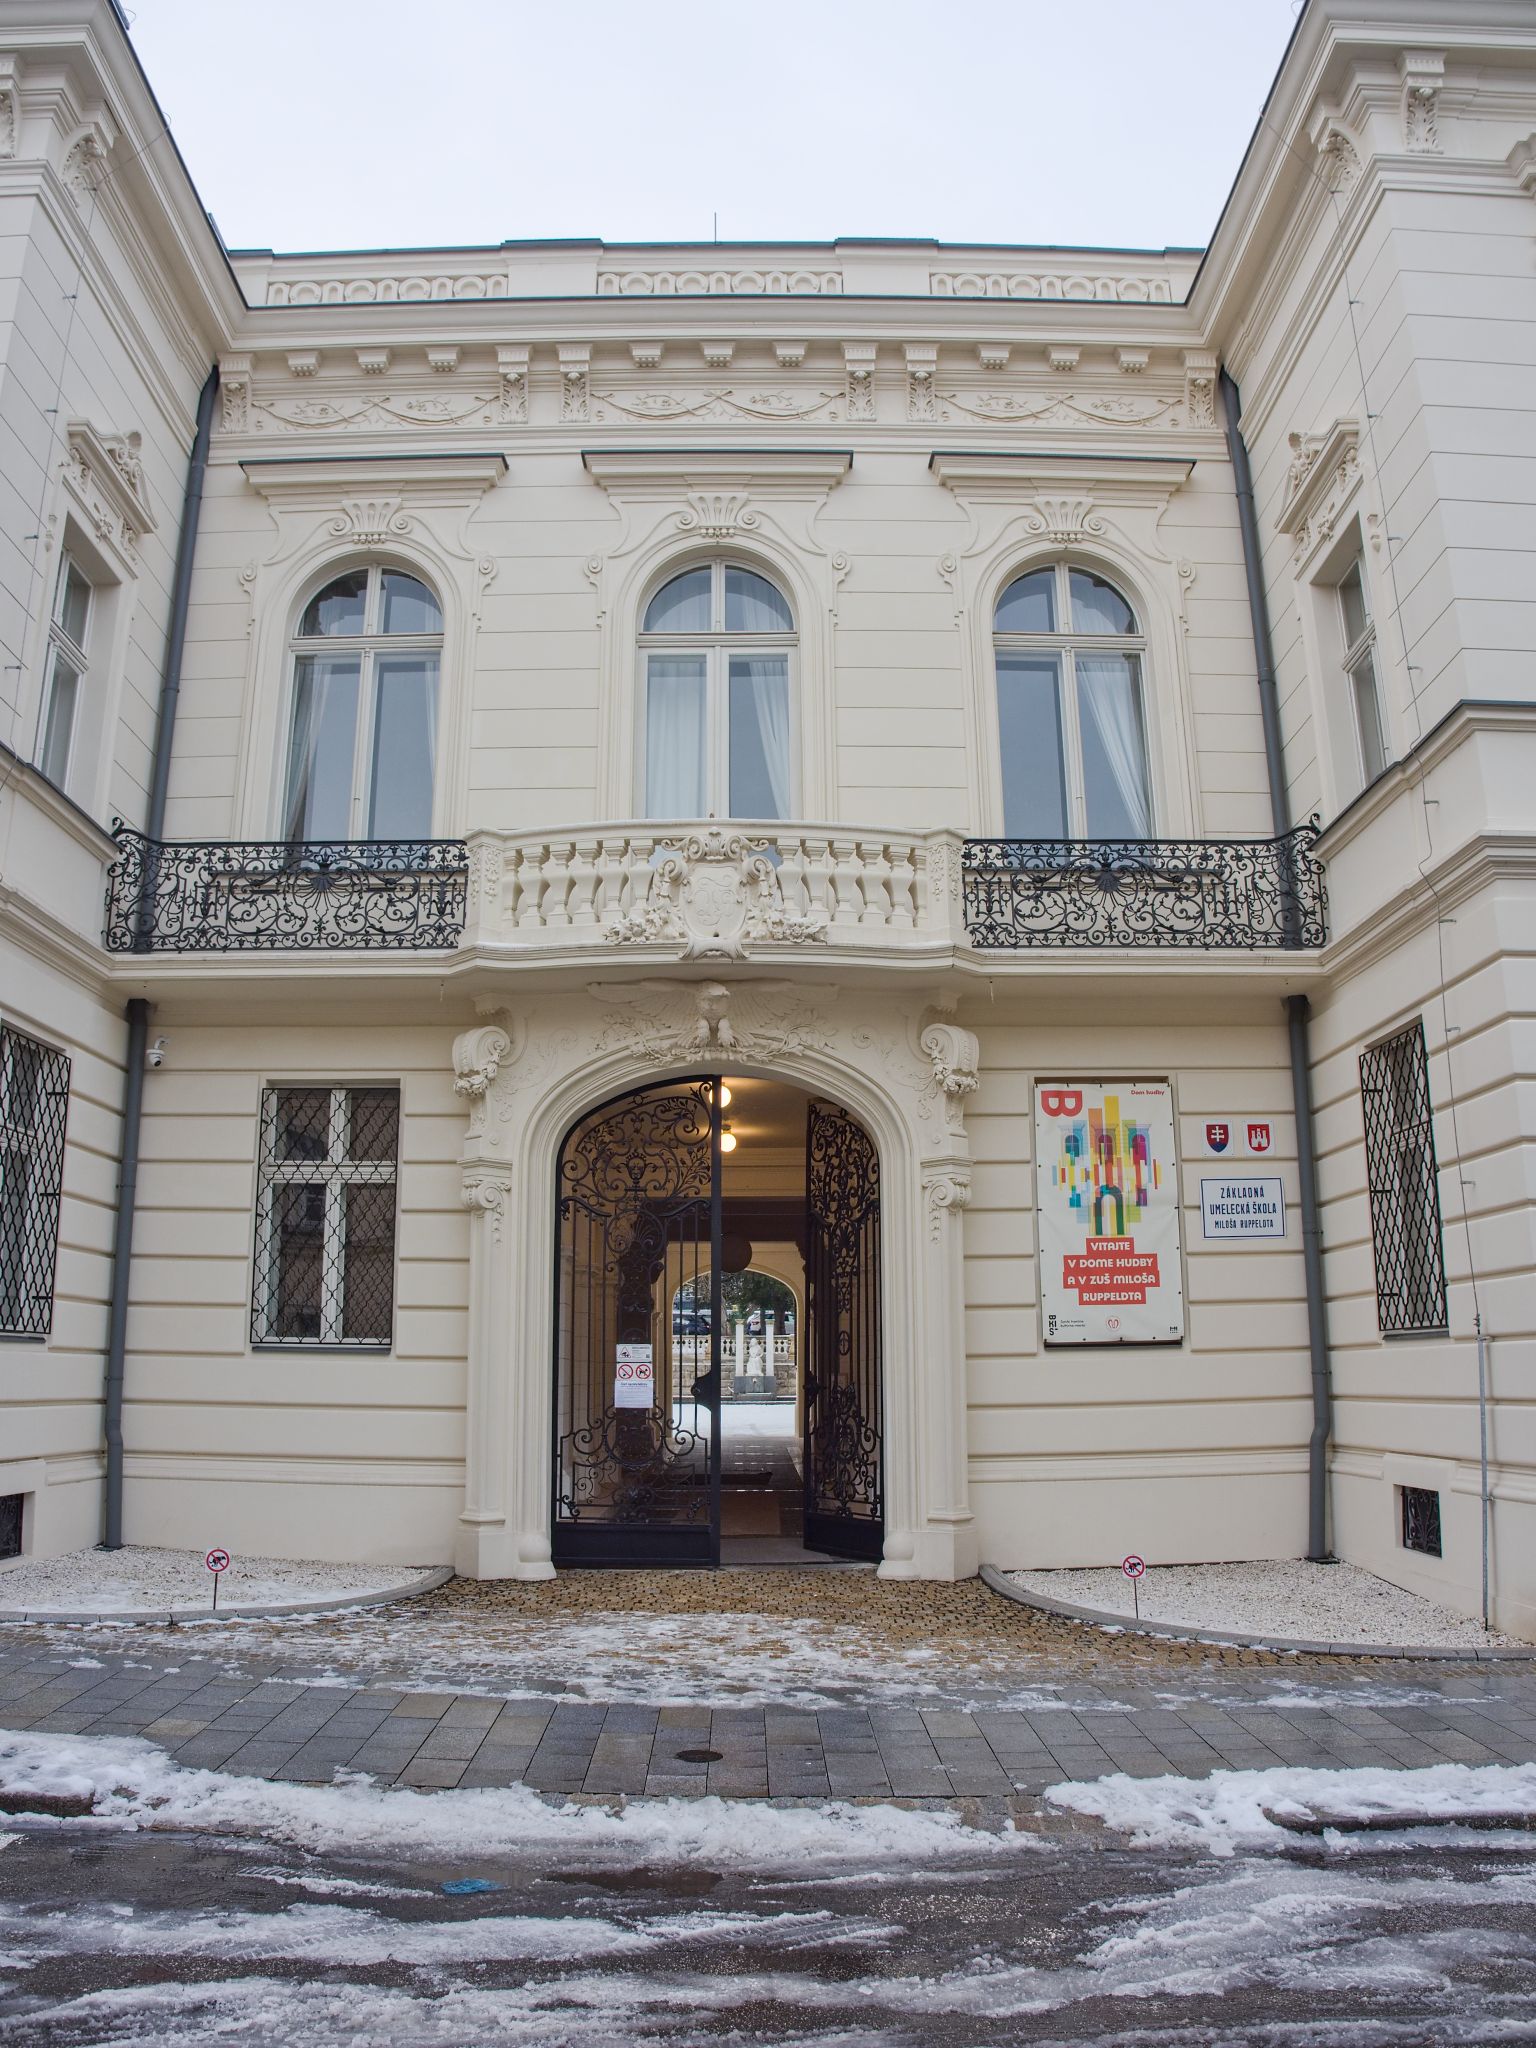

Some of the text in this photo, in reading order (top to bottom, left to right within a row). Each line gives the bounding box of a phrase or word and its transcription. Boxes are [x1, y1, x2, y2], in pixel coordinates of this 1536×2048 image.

[1220, 1185, 1265, 1199] ZÁKLADNÁ
[1209, 1201, 1277, 1215] UMELECKÁ ŠKOLA
[1214, 1217, 1274, 1229] MILOŠA RUPPELDTA
[1091, 1242, 1130, 1250] VITAJTE
[1068, 1258, 1154, 1268] V DOME HUDBY
[1068, 1272, 1156, 1285] A V ZUŠ MILOŠA
[1083, 1292, 1141, 1301] RUPPELDTA
